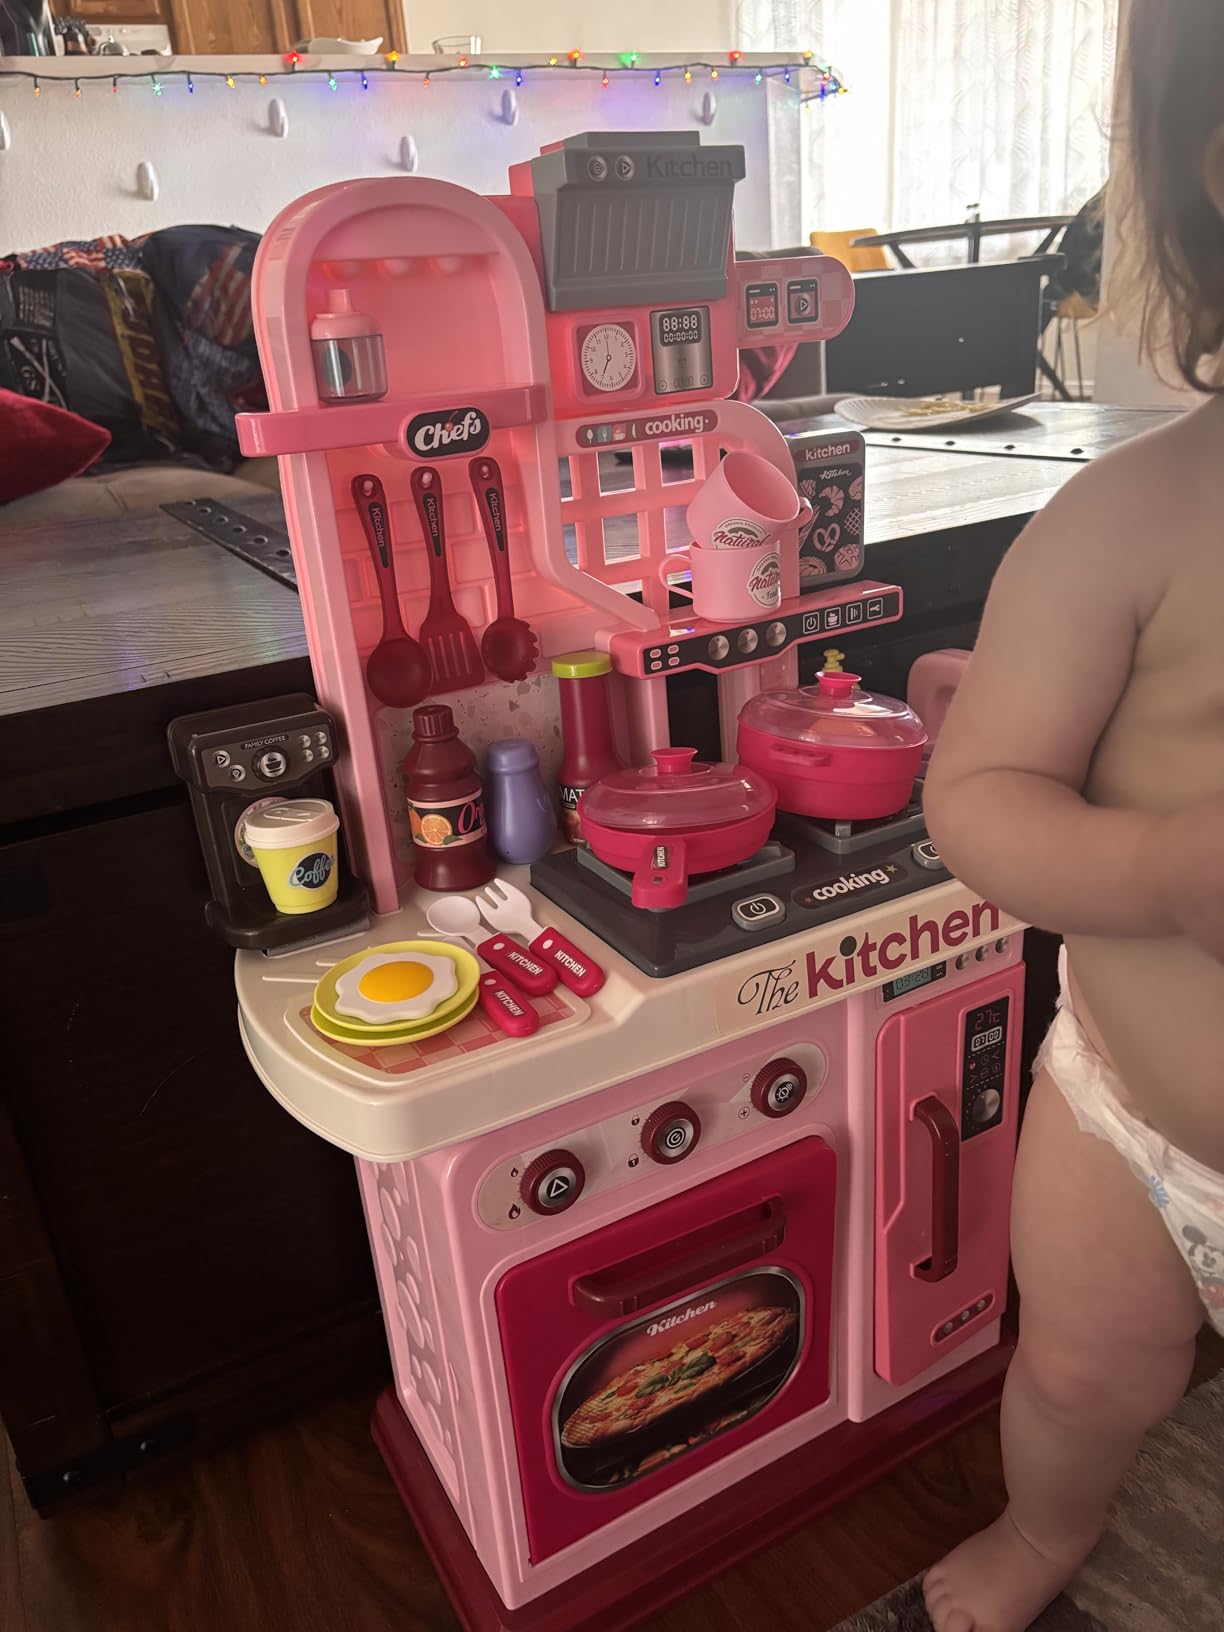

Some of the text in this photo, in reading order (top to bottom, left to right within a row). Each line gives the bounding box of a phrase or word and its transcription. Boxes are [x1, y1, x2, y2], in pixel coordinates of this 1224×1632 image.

[647, 154, 733, 178] Kitchen
[662, 315, 698, 331] 88:88
[663, 330, 699, 342] 00:00:00
[645, 412, 704, 436] cooking
[805, 443, 850, 460] kitchen
[426, 497, 439, 537] Kitchen
[489, 492, 502, 532] Kitchen
[371, 507, 385, 547] Kitchen
[244, 735, 286, 749] FAMILY COFFEE
[657, 846, 666, 868] KITCHEN
[812, 867, 890, 901] cooking
[508, 951, 543, 975] KITCHEN
[554, 949, 587, 977] KITCHEN
[737, 901, 1000, 1016] The kitchen
[495, 990, 525, 1016] KITCHEN
[646, 1300, 717, 1337] Kitchen
